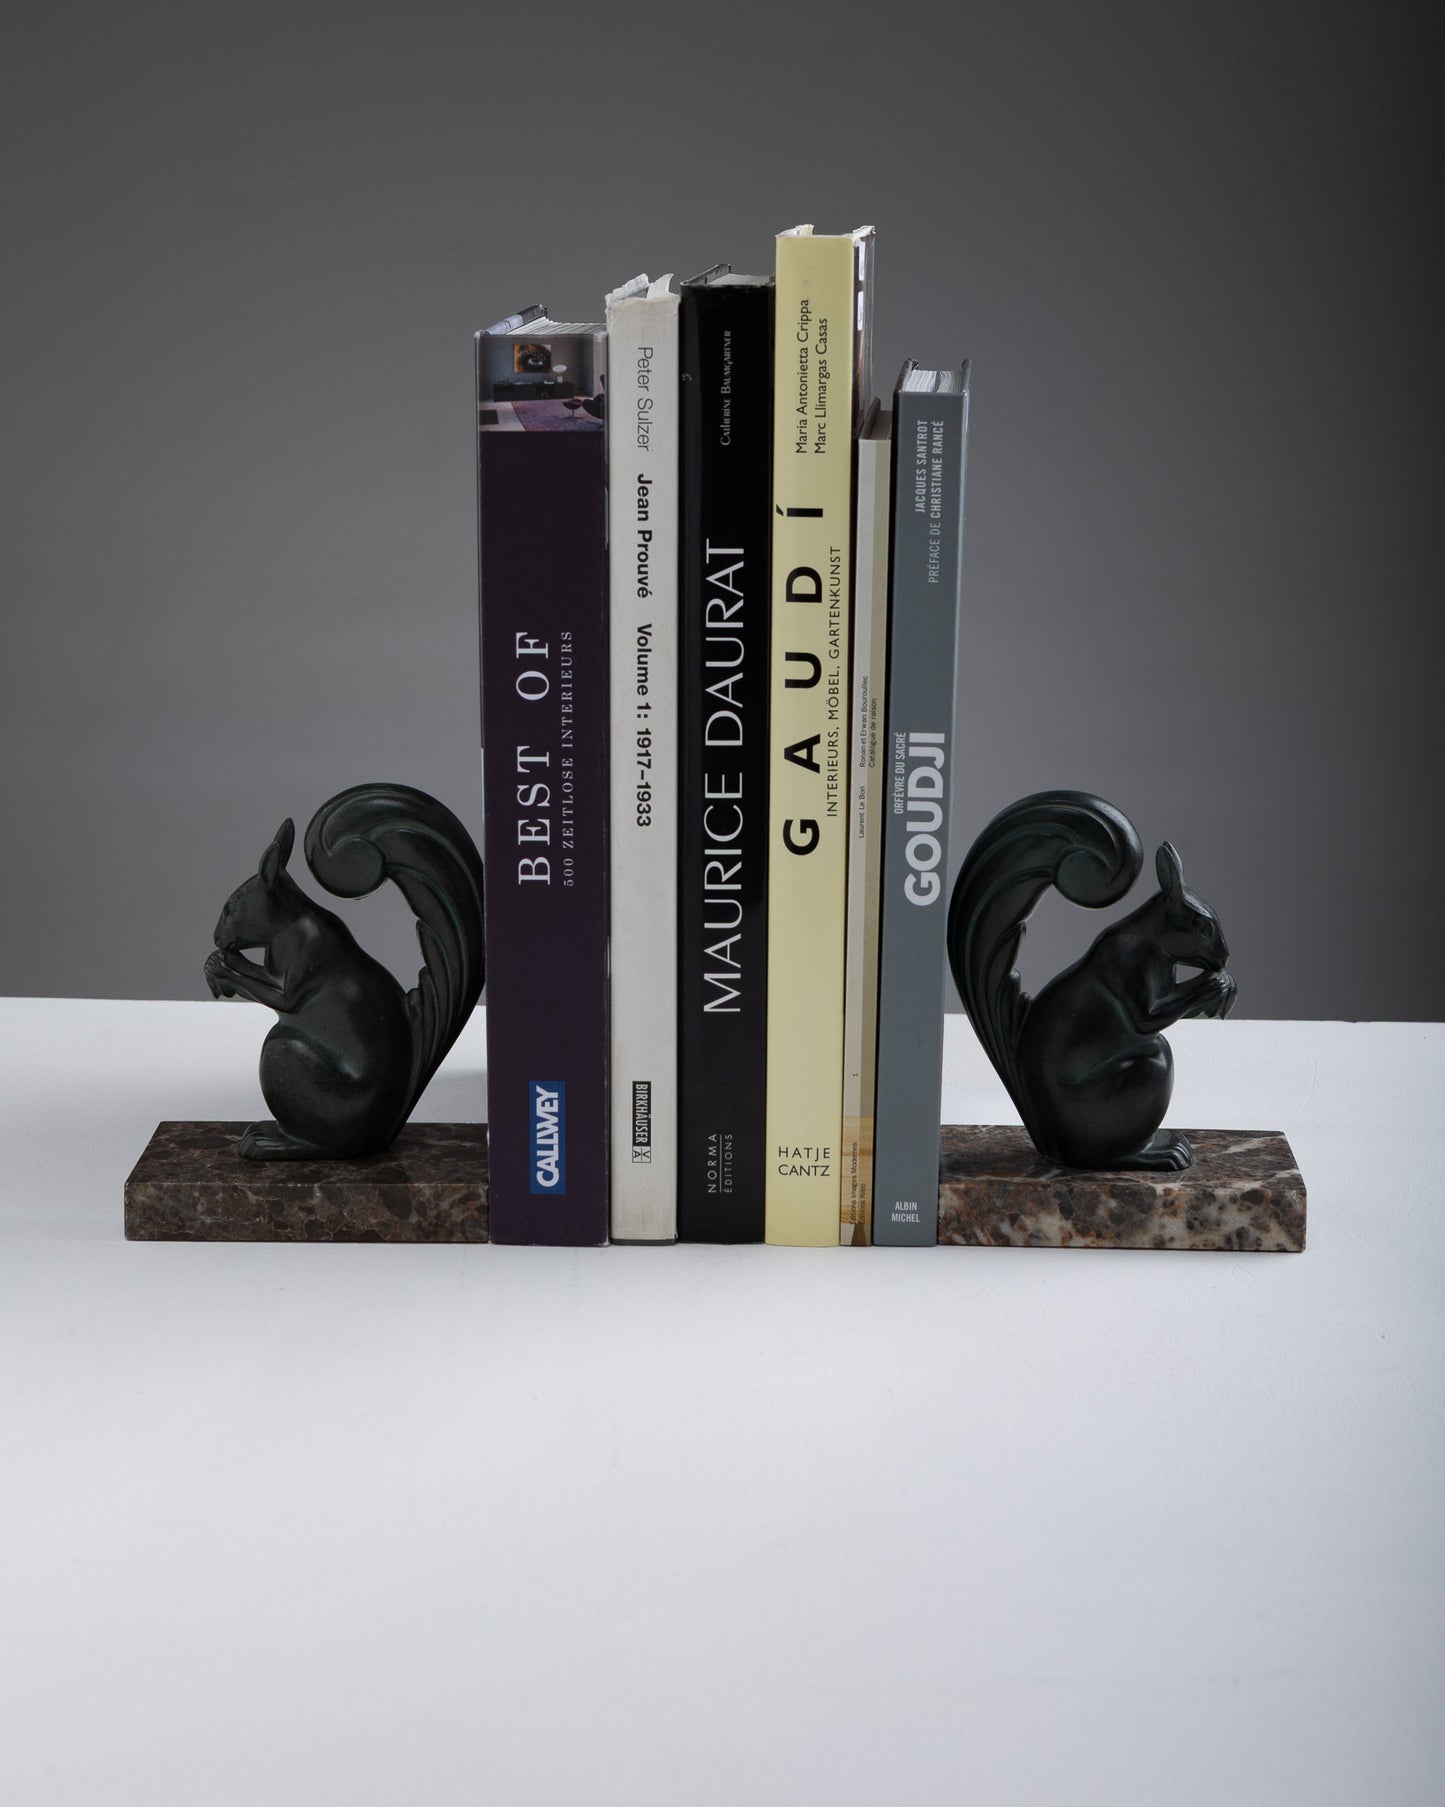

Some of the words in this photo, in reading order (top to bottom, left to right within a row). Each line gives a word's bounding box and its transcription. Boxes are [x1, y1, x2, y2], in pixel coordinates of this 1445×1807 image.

[797, 299, 811, 342] Crippa
[815, 318, 828, 355] Casas
[638, 347, 653, 391] Peter
[796, 347, 808, 415] Antonietta
[815, 360, 830, 417] Llimargas
[637, 398, 653, 451] Sulzer
[796, 418, 807, 453] Maria
[814, 423, 826, 453] Marc
[916, 420, 928, 464] SANTROT
[930, 421, 943, 453] RANCÉ
[638, 474, 652, 521] Jean
[915, 469, 926, 512] JACQUES
[930, 458, 942, 518] CHRISTIANE
[930, 523, 940, 535] DE
[637, 530, 652, 598] Prouvé
[928, 540, 940, 583] PRÉFACE
[829, 546, 840, 659] GARTENKUNST
[637, 624, 652, 695] Volume
[705, 538, 744, 746] DAURAT
[516, 632, 549, 700] OF
[561, 632, 572, 747] INTERIEURS
[637, 702, 651, 719] 1:
[826, 666, 840, 719] MÖBEL,
[860, 676, 869, 713] Bouroullec
[860, 714, 868, 736] Erwan
[860, 737, 867, 745] et
[869, 722, 877, 731] de
[894, 732, 907, 760] SACRÉ
[827, 727, 839, 816] INTERIEURS,
[859, 746, 867, 768] Ronan
[868, 732, 877, 768] Catalogue
[894, 761, 905, 774] DU
[562, 759, 573, 848] ZEITLOSE
[858, 785, 866, 799] Bon
[858, 801, 866, 810] Le
[892, 776, 905, 814] ORFÈVRE
[517, 746, 550, 885] BEST
[858, 812, 866, 839] Laurent
[904, 732, 945, 906] GOUDJI
[564, 859, 573, 886] 500
[704, 772, 743, 1012] MAURICE
[635, 1083, 651, 1143] BIRKHÄUSER
[535, 1086, 560, 1188] CALLWEY
[779, 1147, 830, 1162] HATJE
[707, 1134, 717, 1192] NORMA
[723, 1135, 732, 1192] ÉDITIONS
[778, 1164, 830, 1177] CANTZ
[891, 1213, 920, 1223] MICHEL
[894, 1202, 917, 1211] ALBIN
